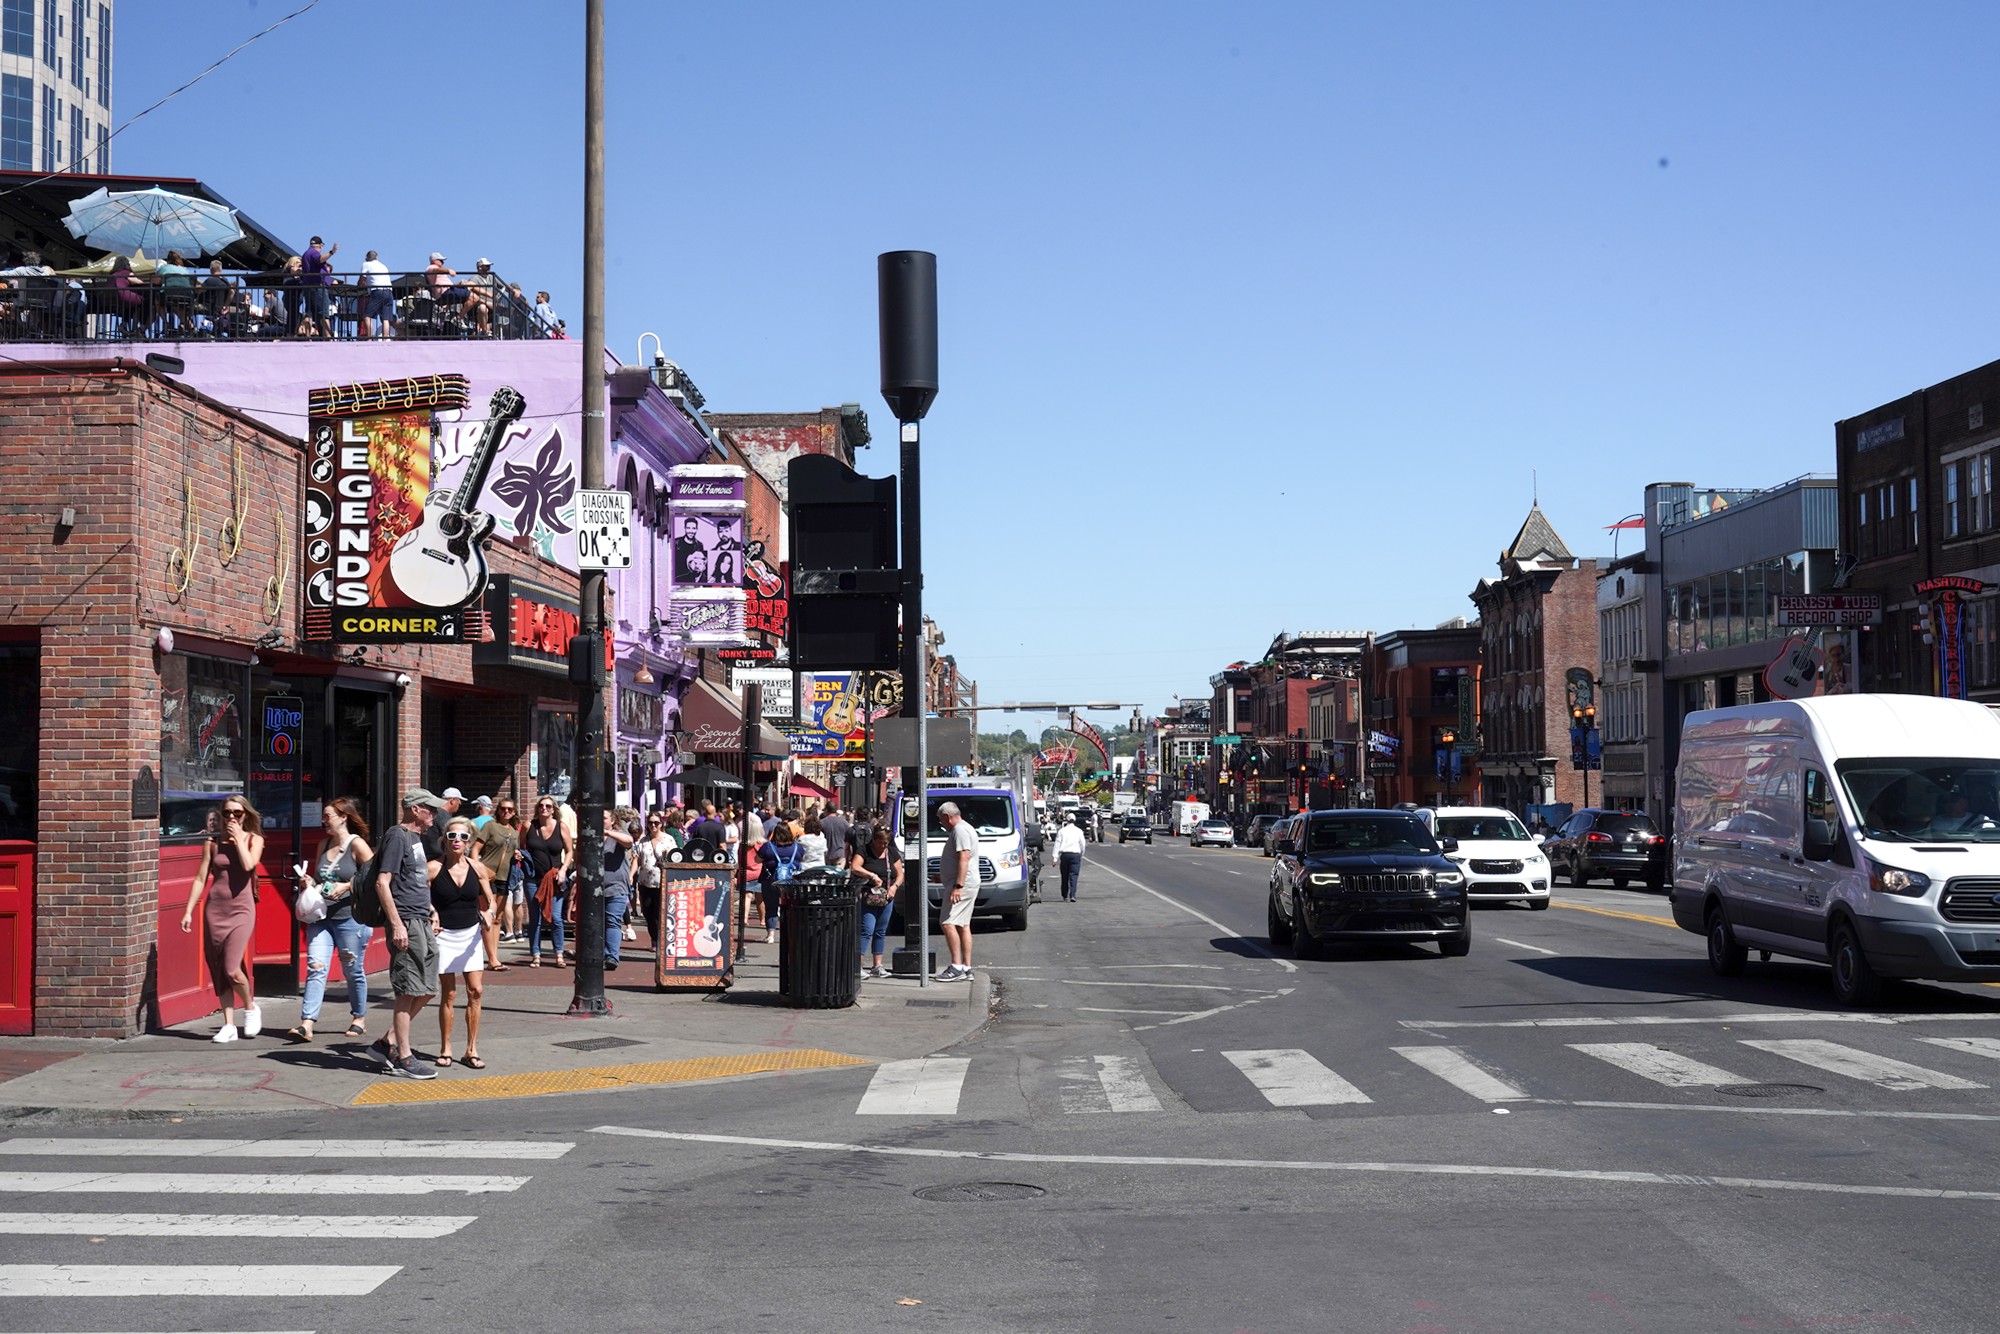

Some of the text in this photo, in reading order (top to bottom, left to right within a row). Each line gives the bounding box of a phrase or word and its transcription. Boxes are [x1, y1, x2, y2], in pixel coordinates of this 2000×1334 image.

[679, 483, 733, 495] World Famous
[582, 495, 625, 509] DIAGONAL
[336, 420, 372, 607] LEGENDS
[583, 510, 625, 524] CROSSING
[579, 530, 600, 557] OK
[1916, 577, 1983, 592] NASHVILLE
[1780, 595, 1880, 608] ERNEST TUBB
[1787, 610, 1873, 624] RECORD SHOP
[342, 617, 437, 634] CORNER
[718, 649, 775, 658] HONKY TONK
[735, 659, 756, 668] CITY
[762, 680, 791, 688] PRAYERS
[763, 688, 781, 696] VILLE
[265, 707, 302, 731] Lite
[694, 723, 741, 737] Second
[694, 735, 741, 749] Fiddle
[802, 736, 823, 745] Tonk
[1370, 730, 1400, 748] HONKY
[791, 744, 813, 752] RILL
[1367, 740, 1393, 756] TONK
[1804, 893, 1821, 907] NES
[676, 891, 688, 957] LEGENDS
[677, 959, 713, 967] CORNER
